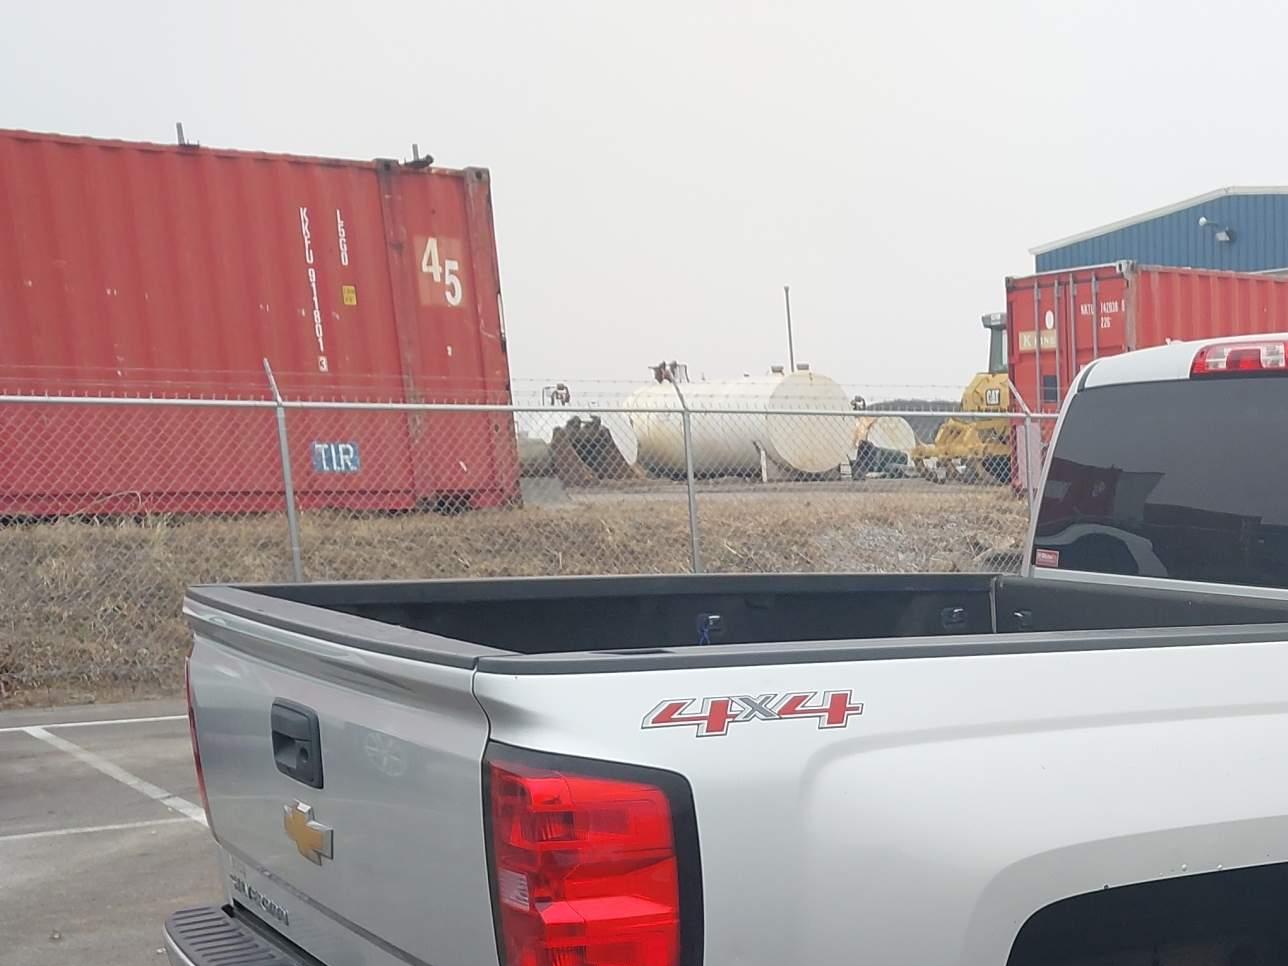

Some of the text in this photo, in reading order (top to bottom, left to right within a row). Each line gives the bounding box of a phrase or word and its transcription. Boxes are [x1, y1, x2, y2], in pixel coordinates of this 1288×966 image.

[421, 236, 462, 306] 45
[308, 268, 324, 352] 911801
[986, 389, 1000, 405] CAT
[314, 443, 358, 471] TIR
